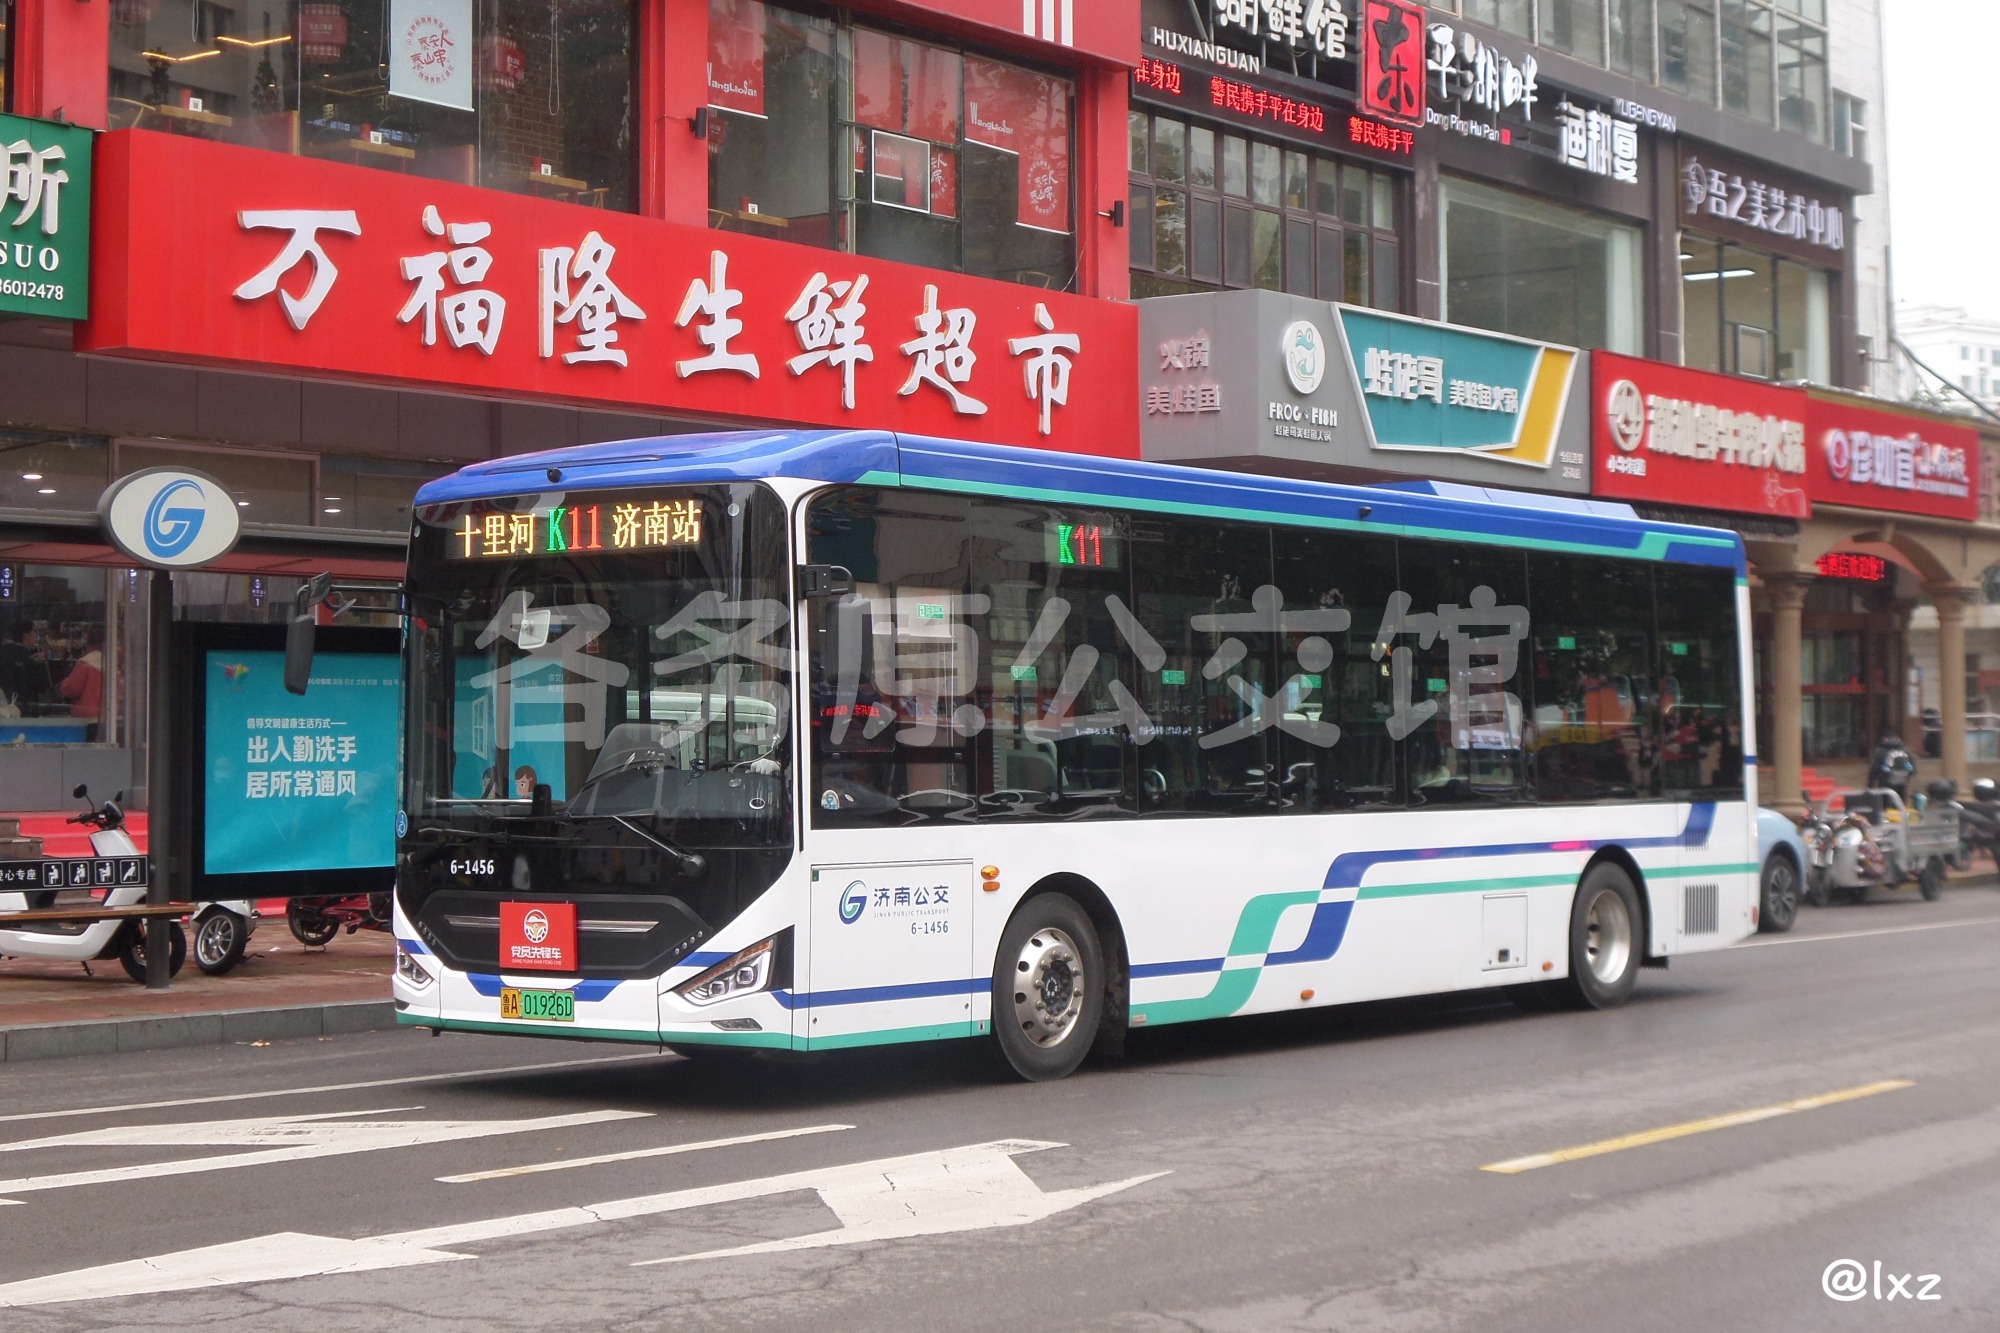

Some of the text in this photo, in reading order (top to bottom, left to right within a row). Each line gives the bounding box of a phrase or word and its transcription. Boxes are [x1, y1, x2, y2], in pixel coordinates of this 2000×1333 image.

[1153, 26, 1260, 74] HUXIANGUAN
[1427, 107, 1500, 141] Dong Ping Hu Pan
[1708, 168, 1844, 250] 吾之美艺术中心
[232, 204, 1081, 435] 万福隆生鲜超市
[1160, 336, 1210, 369] 火锅
[1147, 384, 1221, 414] 美蛙鱼
[1449, 378, 1519, 413] 美蛙鱼火锅
[1268, 401, 1338, 427] FROG FISH
[455, 500, 702, 558] 十里河 K11 济南站
[1058, 524, 1102, 566] K11
[246, 770, 356, 798] 居所常通风
[450, 858, 495, 876] 6-1456
[873, 884, 949, 908] 济南公交
[893, 909, 914, 917] PUBLIC
[916, 908, 949, 916] TRANSPORT
[911, 920, 949, 935] 6-1456
[511, 945, 562, 960] 党员先锋车
